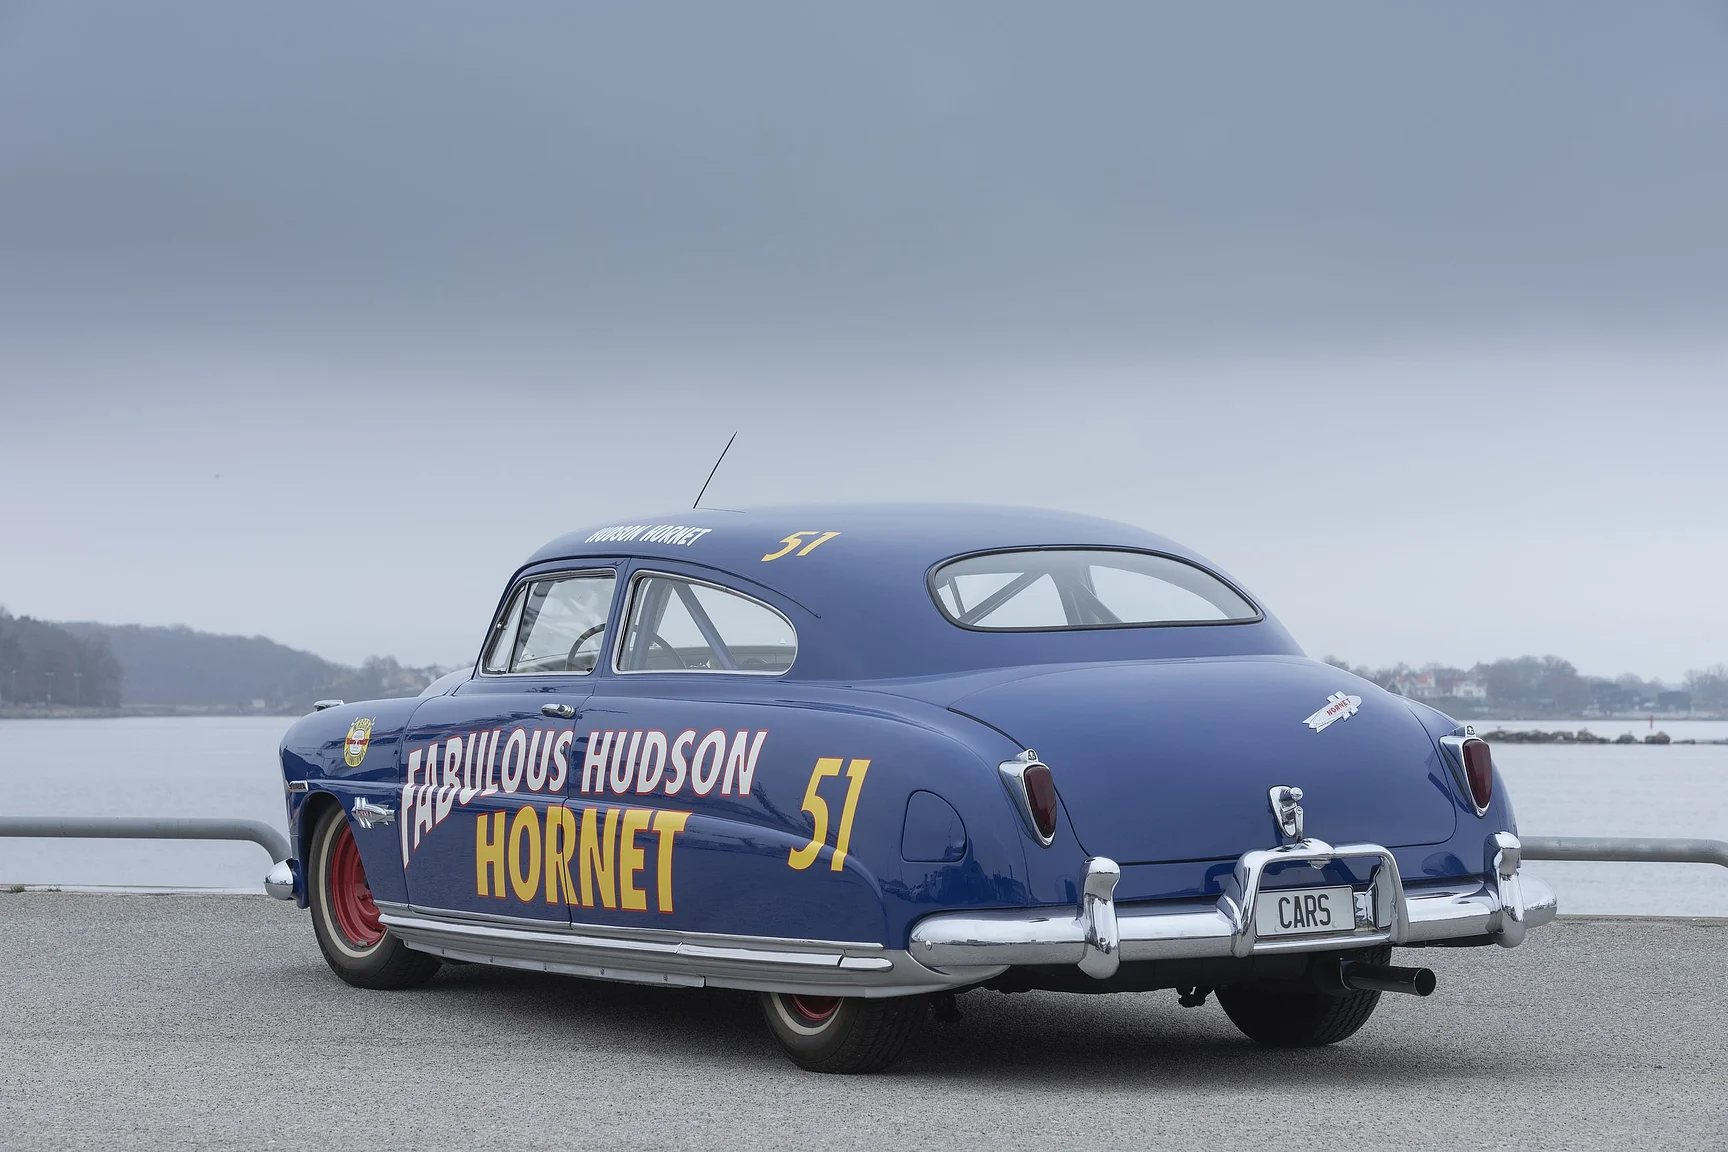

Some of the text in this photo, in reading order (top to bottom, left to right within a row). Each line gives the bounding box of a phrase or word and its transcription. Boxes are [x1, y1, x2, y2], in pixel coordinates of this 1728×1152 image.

[583, 524, 713, 547] HUDSON HORNET
[760, 530, 842, 562] 51
[1326, 697, 1351, 716] HORNET
[400, 727, 770, 870] FABULOUS HUDSON
[787, 756, 872, 872] 51
[475, 804, 694, 914] HORNET
[1278, 893, 1332, 929] CARS
